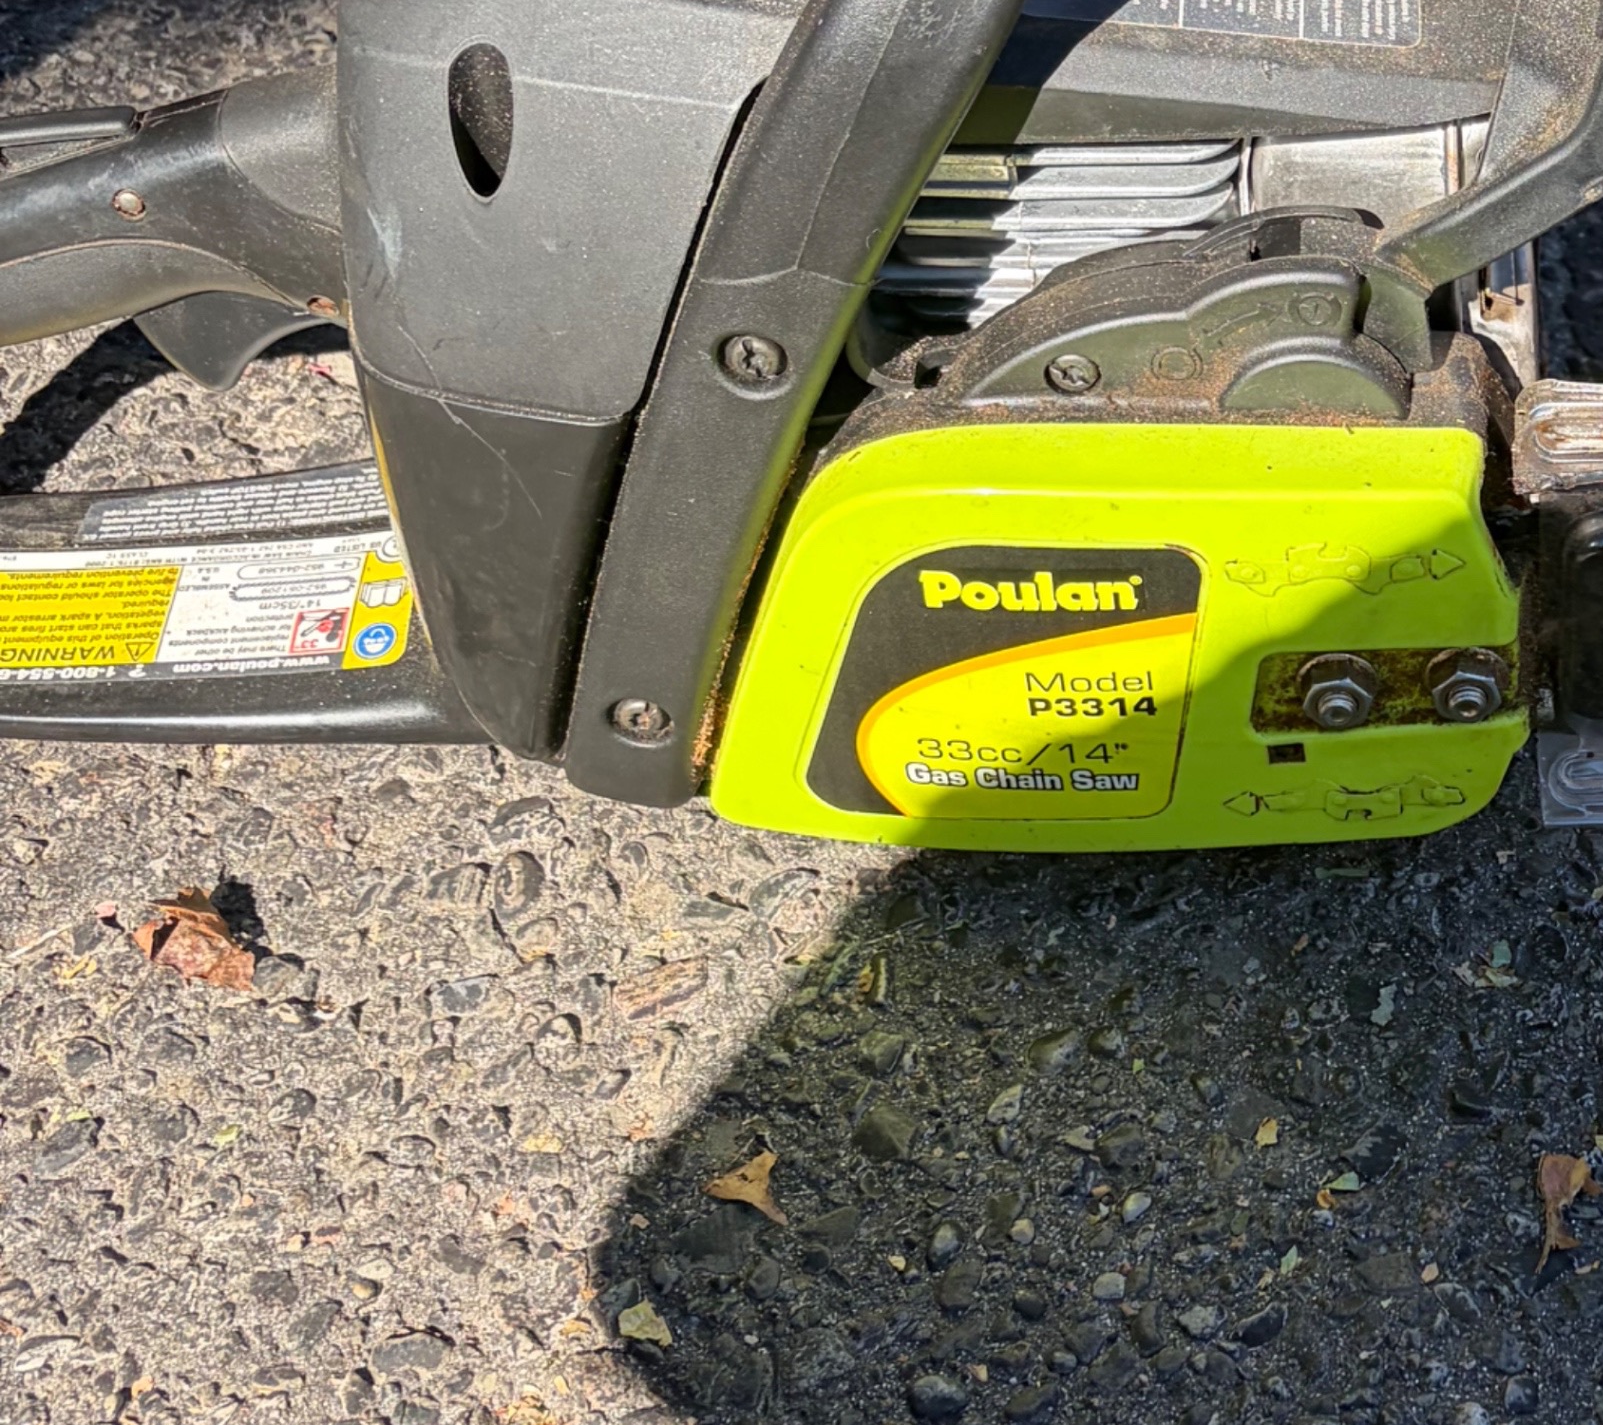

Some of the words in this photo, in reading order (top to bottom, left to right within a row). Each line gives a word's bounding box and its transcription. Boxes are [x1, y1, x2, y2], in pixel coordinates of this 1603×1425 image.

[87, 569, 144, 579] prevention
[0, 581, 63, 591] regulations
[919, 570, 1139, 612] Poulan
[17, 593, 59, 601] contact
[62, 592, 99, 601] should
[102, 589, 149, 599] operator
[152, 589, 171, 597] The
[122, 599, 169, 608] required.
[12, 615, 57, 624] arrestor
[60, 612, 90, 622] spark
[92, 613, 103, 621] A
[22, 625, 46, 633] fires
[49, 625, 74, 633] start
[101, 623, 122, 631] that
[126, 620, 162, 630] sparks
[4, 634, 64, 644] equipment
[67, 635, 87, 643] this
[90, 634, 100, 643] of
[105, 632, 159, 642] Operation
[169, 637, 228, 647] components
[0, 646, 115, 662] WARNING
[173, 655, 330, 673] www.poulan.com
[1025, 671, 1154, 693] Model
[1027, 697, 1157, 717] P3314
[905, 762, 968, 787] Gas
[975, 767, 1063, 790] Chain
[1071, 769, 1139, 790] Saw
